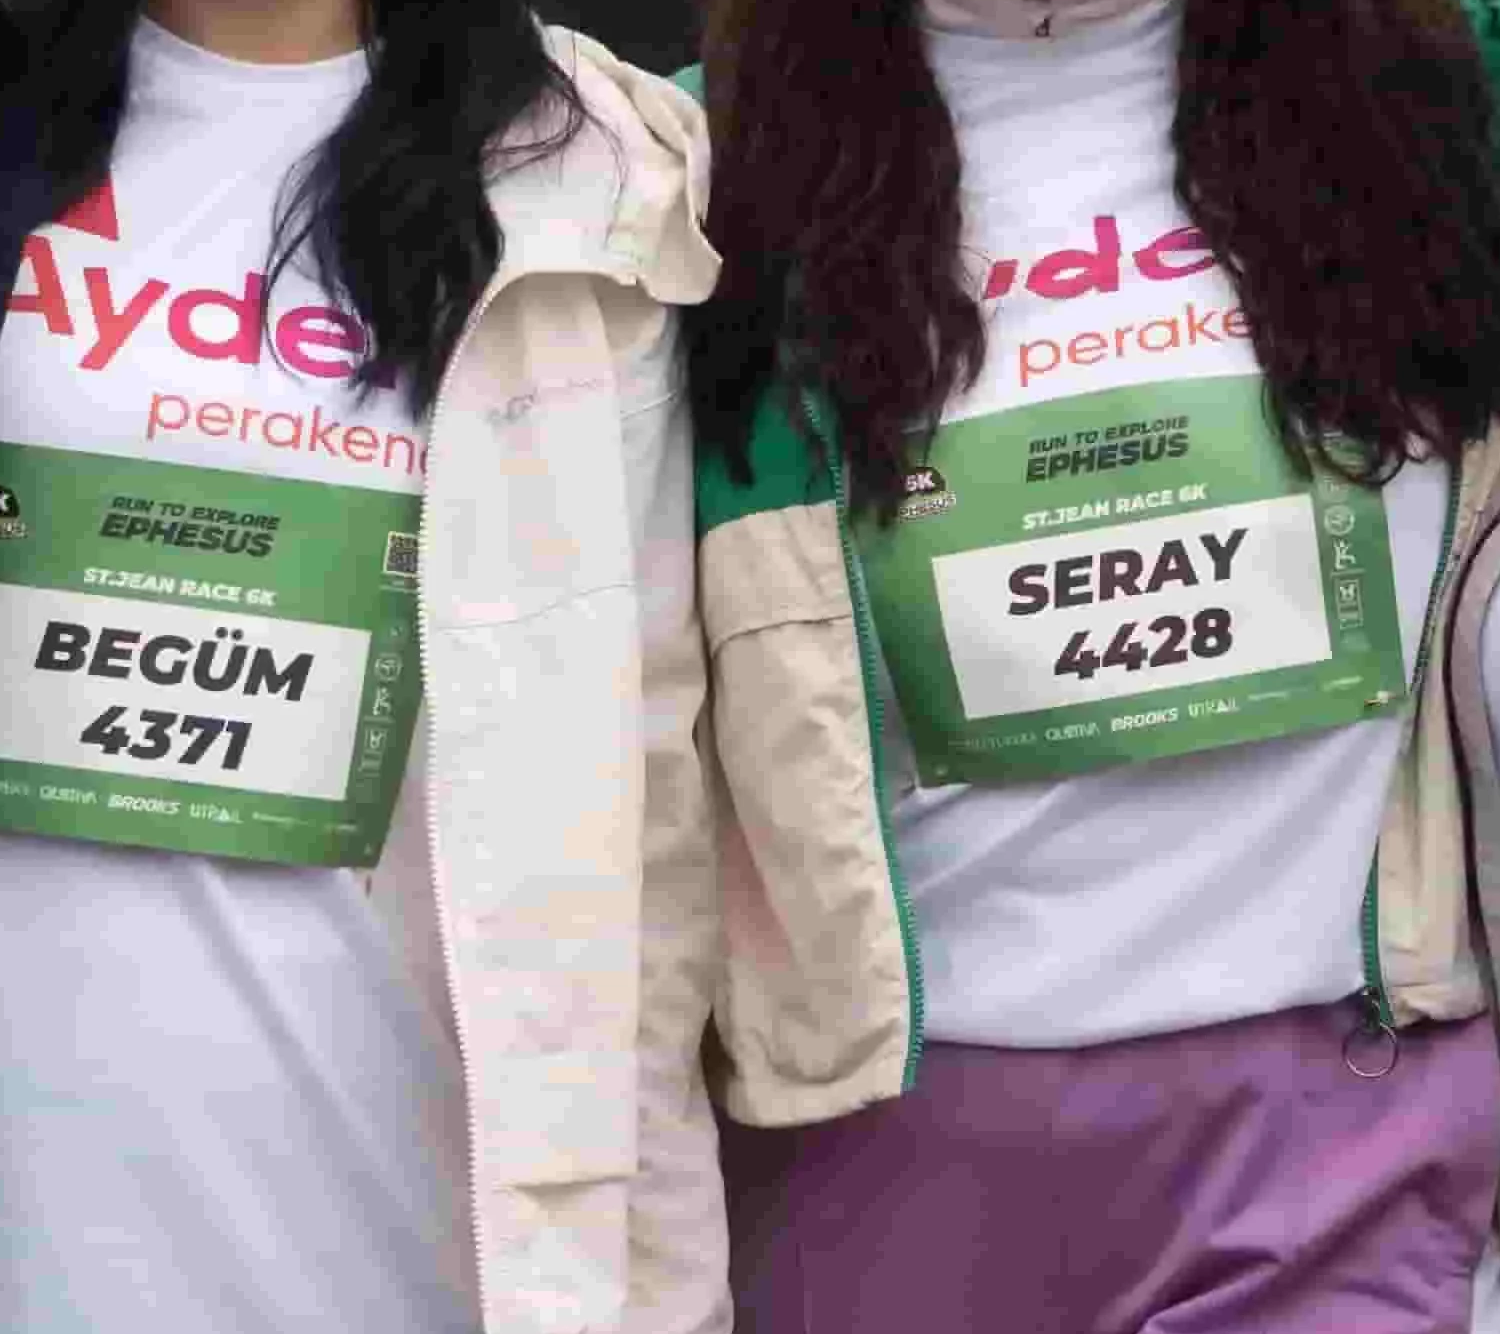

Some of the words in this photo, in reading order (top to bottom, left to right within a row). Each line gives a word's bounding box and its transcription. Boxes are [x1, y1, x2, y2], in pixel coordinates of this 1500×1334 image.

[1029, 435, 1068, 454] RUN
[1074, 430, 1100, 445] TO
[1104, 416, 1189, 441] EXPLORE
[1026, 433, 1189, 483] EPHESUS
[111, 496, 153, 512] RUN
[159, 501, 187, 517] TO
[191, 505, 282, 530] EXPLORE
[1116, 488, 1173, 513] RACE
[1179, 483, 1208, 501] 6K
[99, 513, 275, 558] EPHESUS
[179, 577, 242, 602] RACE
[245, 588, 278, 607] 6K
[1008, 527, 1249, 617] SERAY
[34, 620, 315, 701] BEGÜM
[1053, 608, 1234, 680] 4428
[79, 703, 253, 771] 4371
[1110, 707, 1179, 732] BROOKS
[107, 794, 181, 816] BROOKS
